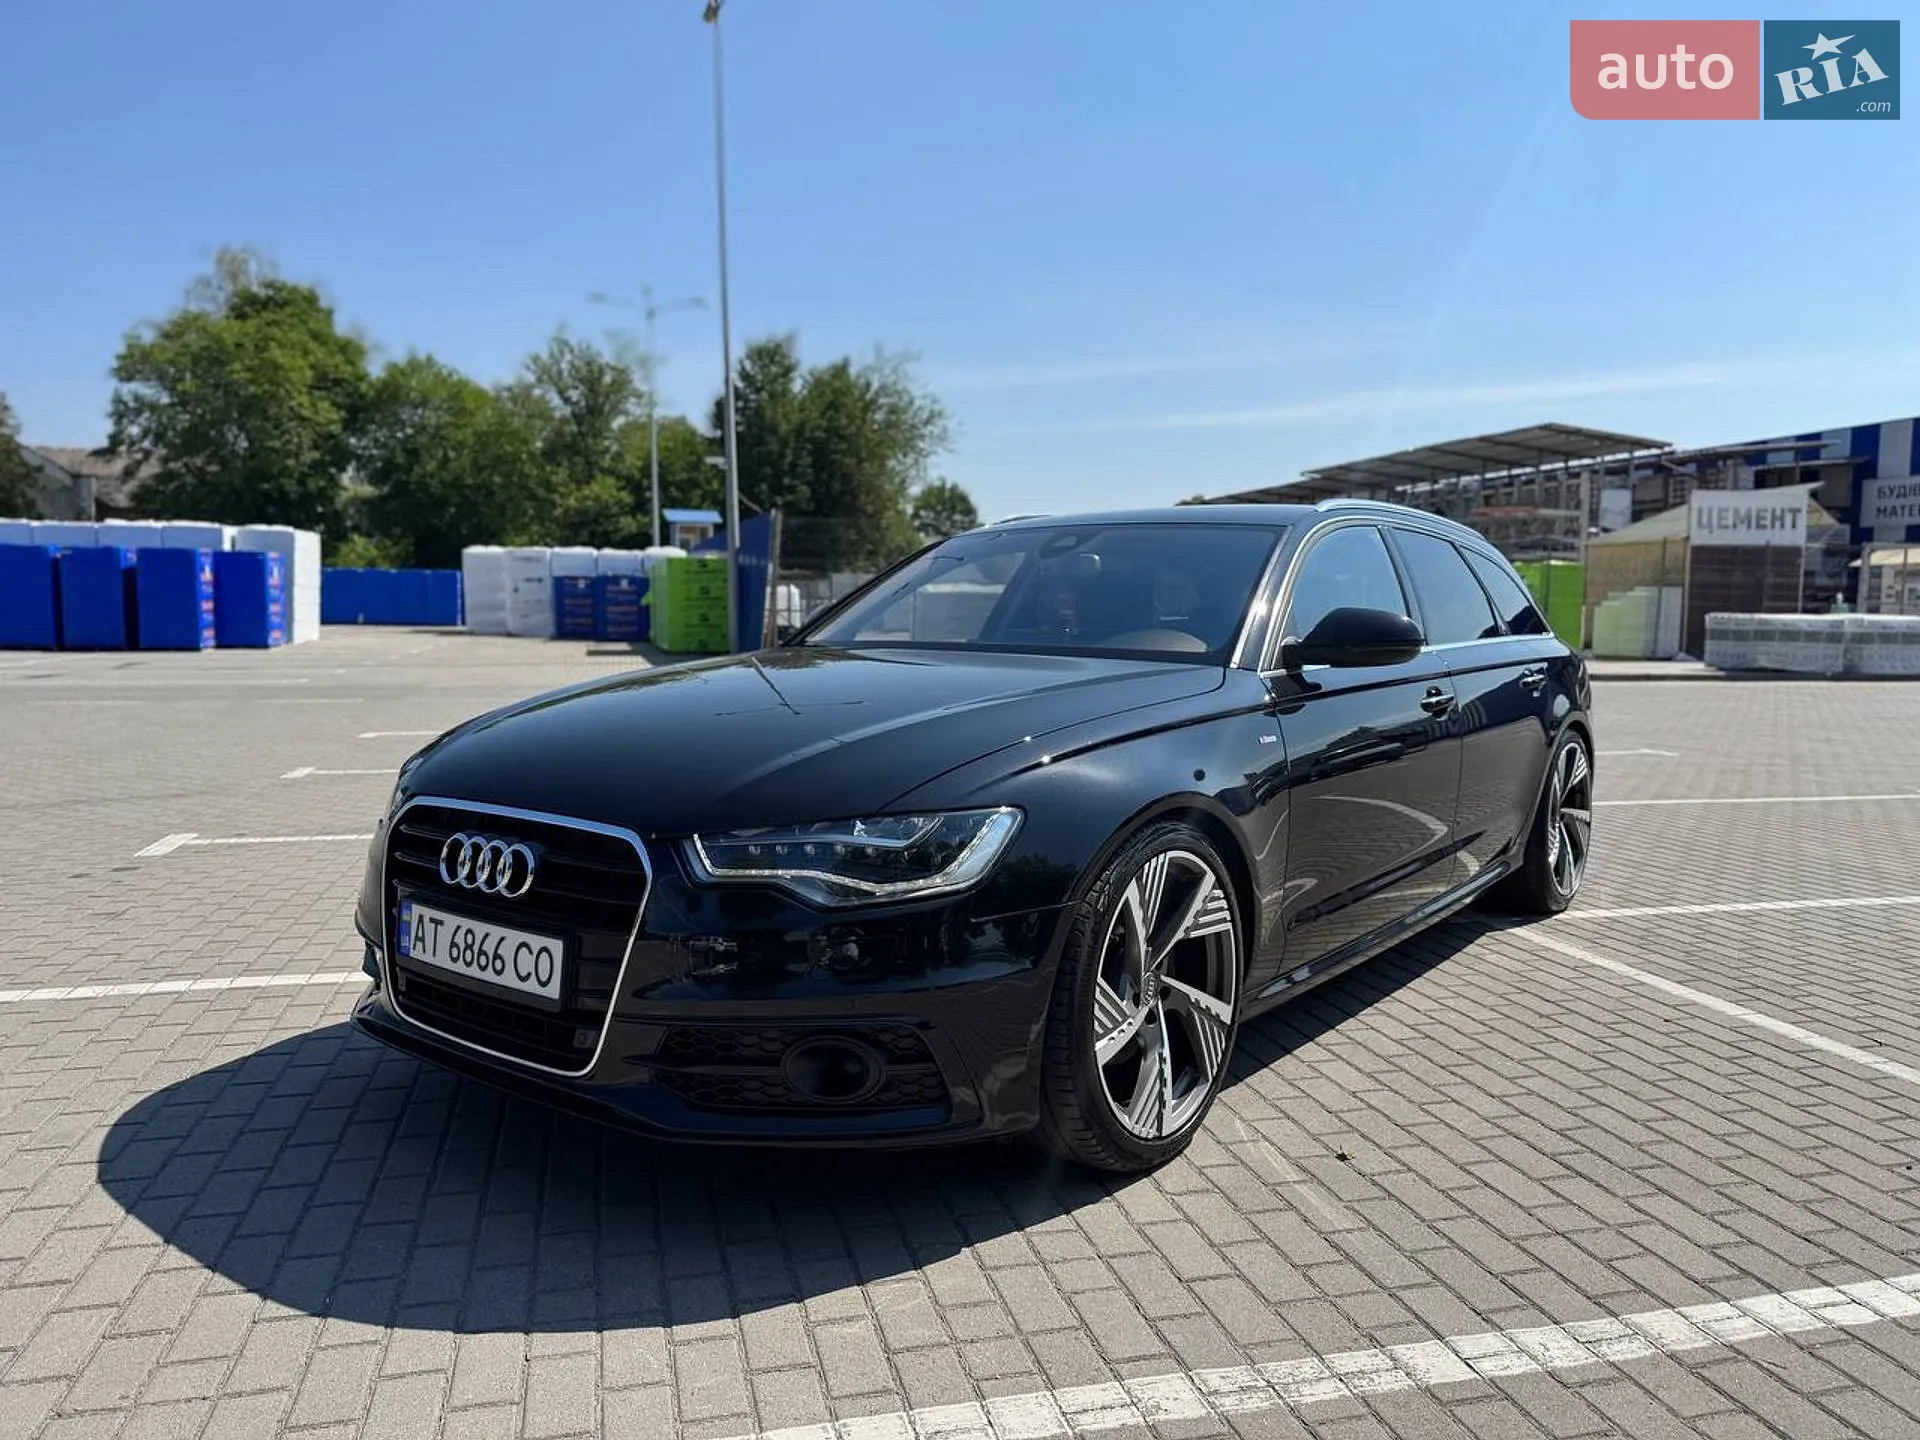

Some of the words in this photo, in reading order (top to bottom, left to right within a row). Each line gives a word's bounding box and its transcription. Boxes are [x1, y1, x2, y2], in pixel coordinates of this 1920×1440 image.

[1697, 506, 1803, 534] ЦЕМЕНТ
[1876, 504, 1920, 519] МАТЕ
[412, 913, 445, 958] AT
[448, 924, 506, 977] 6866
[514, 941, 554, 989] CO
